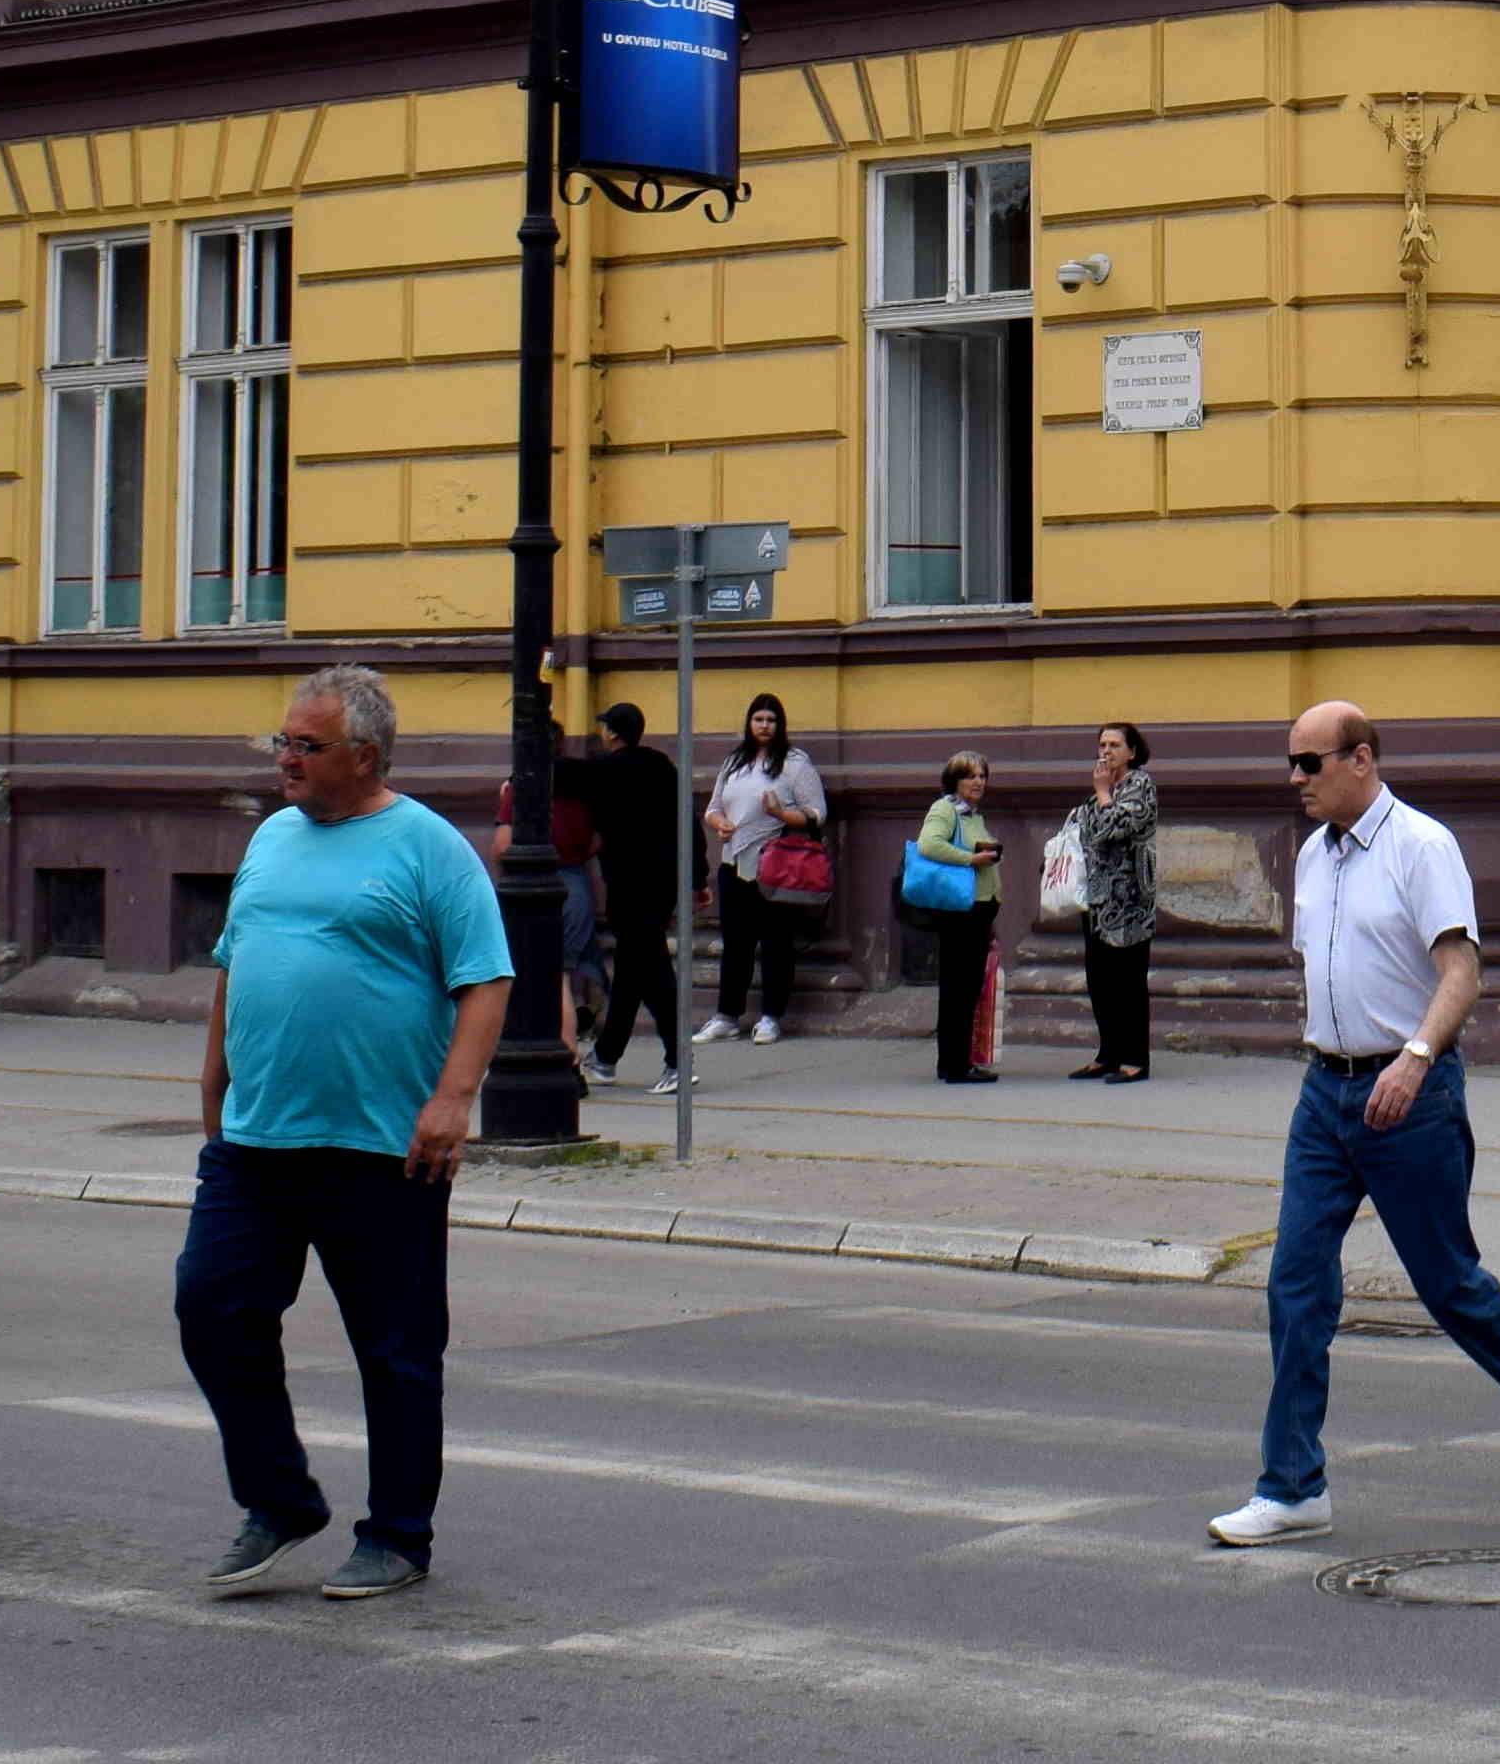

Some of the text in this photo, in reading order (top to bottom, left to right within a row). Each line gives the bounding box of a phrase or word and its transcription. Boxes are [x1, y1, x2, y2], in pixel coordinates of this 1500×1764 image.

[603, 32, 613, 44] U
[615, 34, 661, 48] OKVIRU
[662, 39, 700, 54] HOTELA
